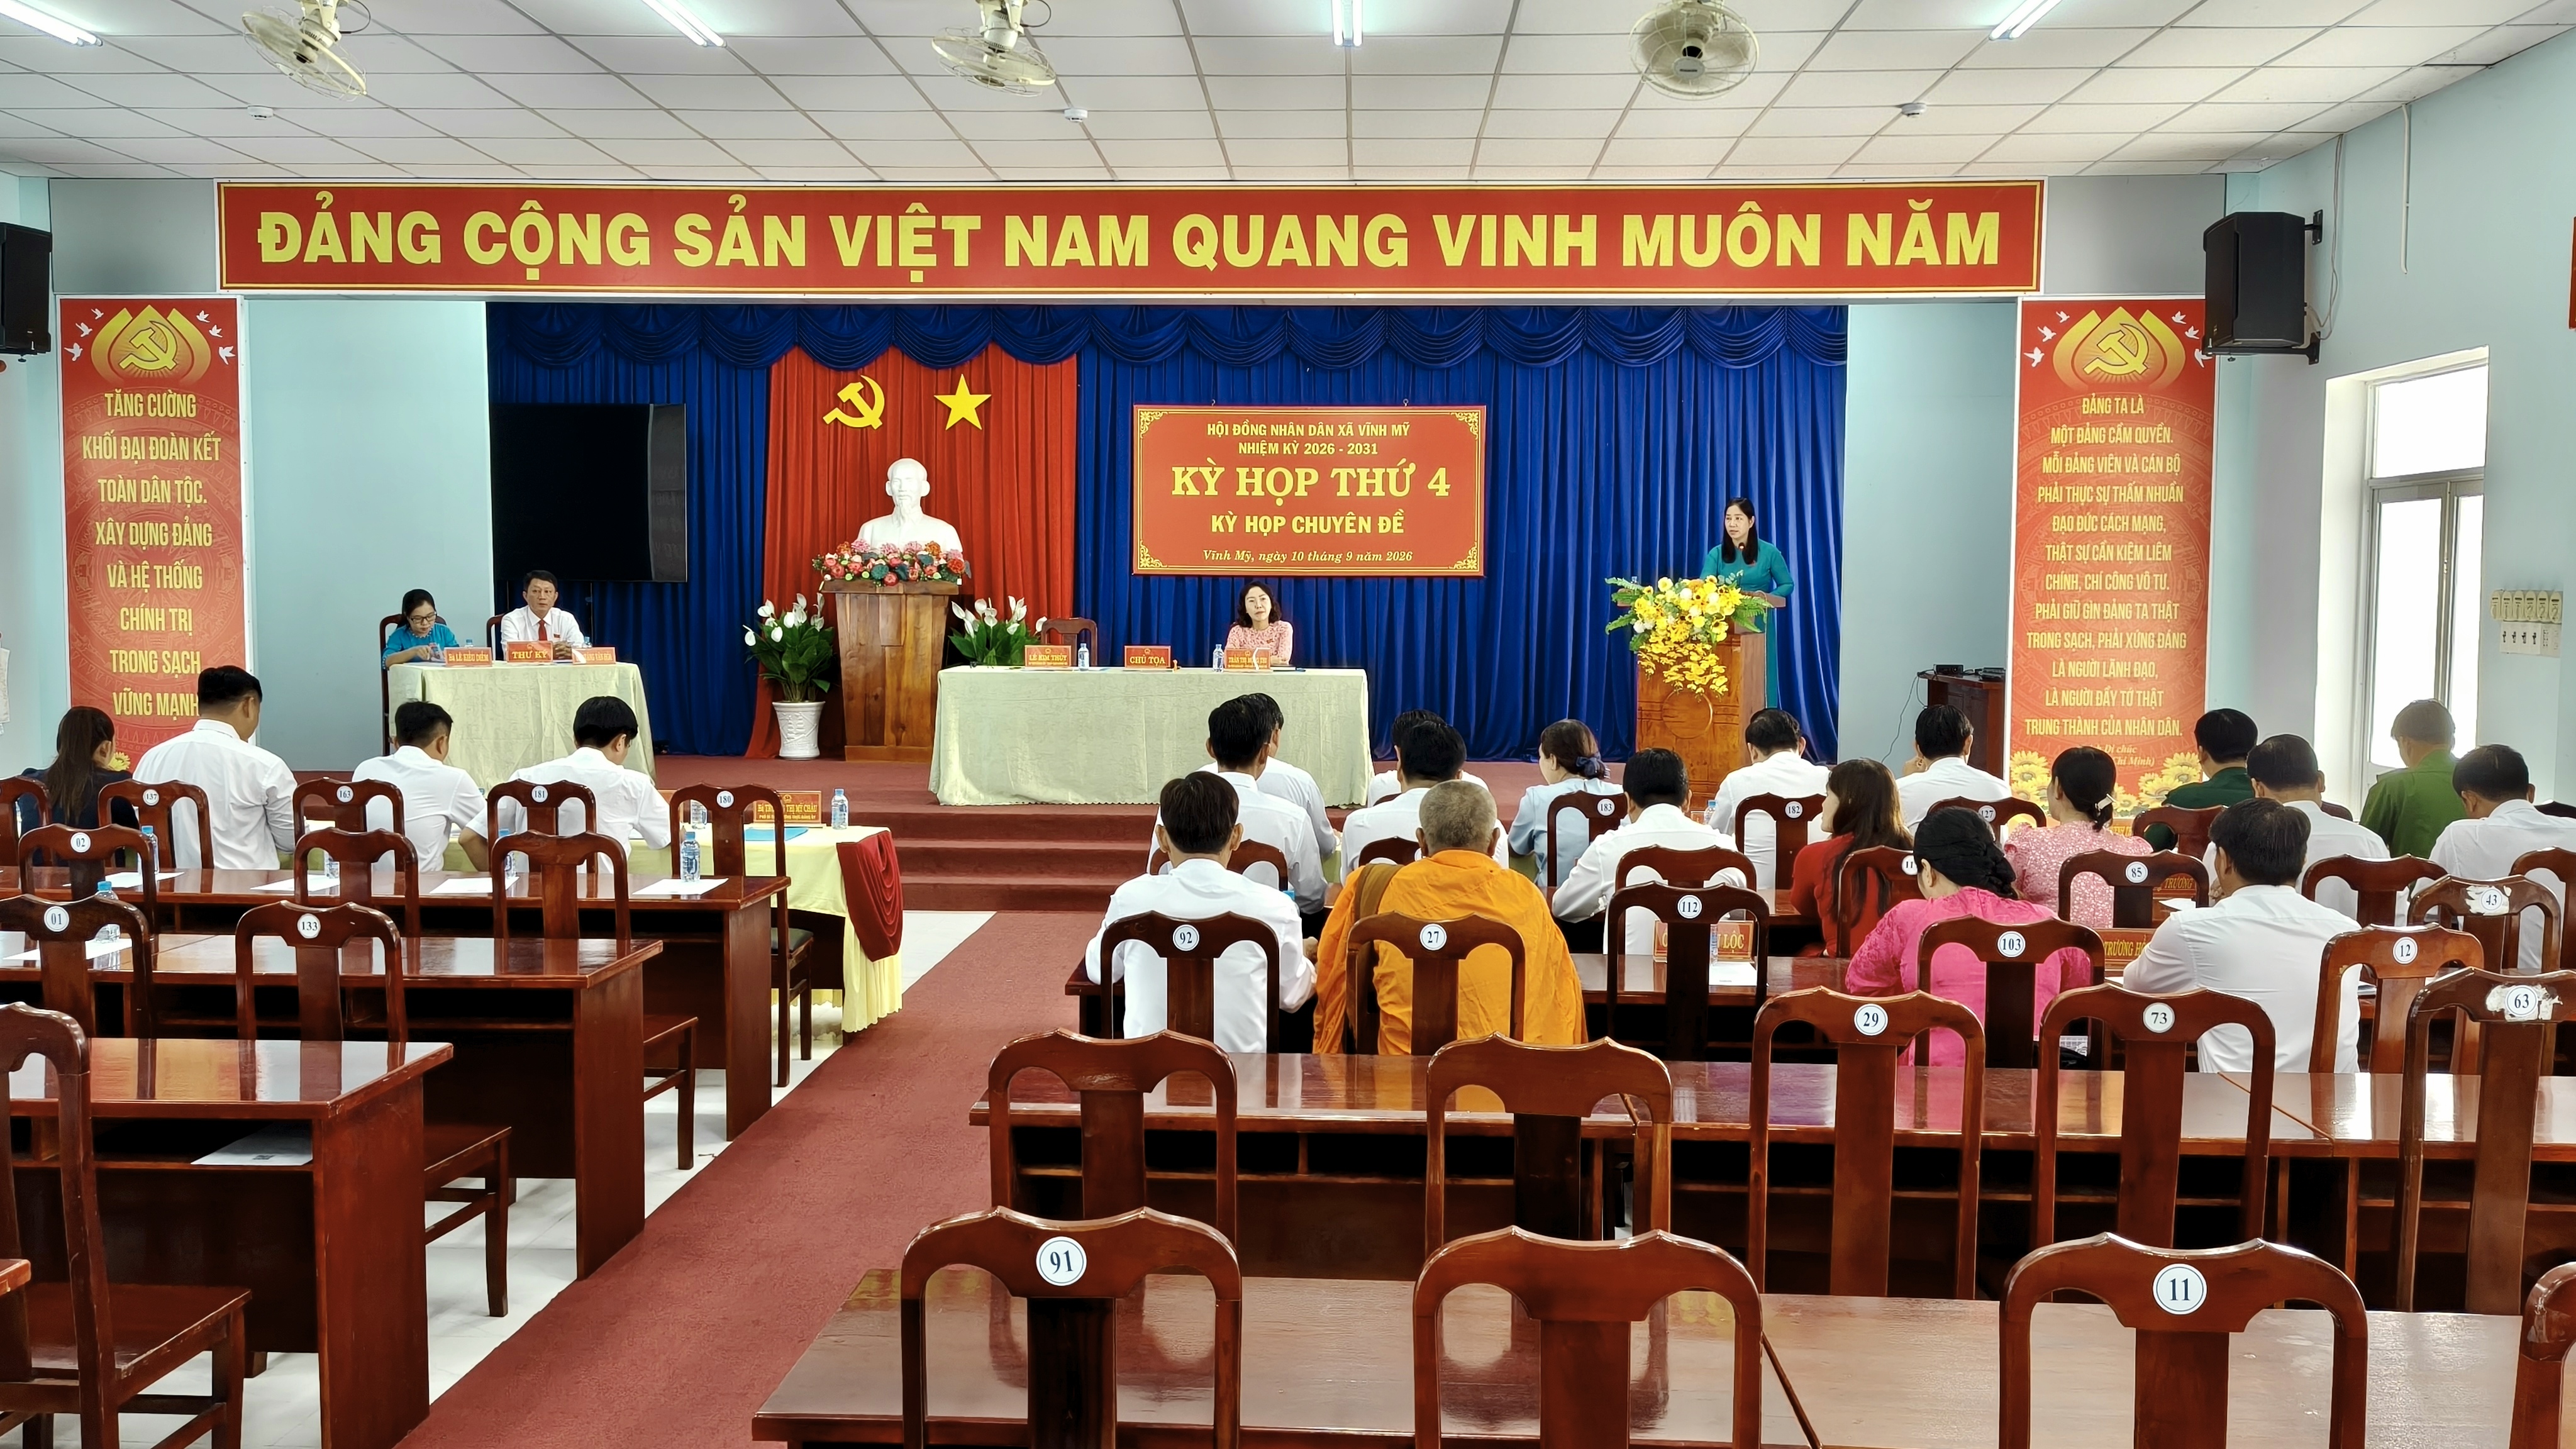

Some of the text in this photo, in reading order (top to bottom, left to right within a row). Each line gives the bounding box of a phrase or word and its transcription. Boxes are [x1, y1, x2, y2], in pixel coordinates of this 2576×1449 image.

[257, 191, 1999, 284] ĐẢNG CỘNG SẢN VIỆT NAM QUANG VINH MUÔN NĂM
[104, 389, 196, 418] TĂNG CƯỜNG
[2082, 392, 2145, 414] ĐẢNG TA LÀ
[1207, 419, 1410, 438] HỘI ĐỒNG NHÂN DÂN XÃ VĨNH MỸ
[2051, 421, 2174, 447] MỘT ĐẢNG CẦM QUYỀN.
[82, 429, 221, 465] KHỐI ĐẠI ĐOÀN KẾT
[1238, 440, 1378, 457] NHIỆM KỲ 2026 2031
[2042, 450, 2180, 476] MỖI ĐẢNG VIÊN VÀ CÁN BỘ
[97, 474, 208, 508] TOÀN DÂN TỘC.
[1172, 457, 1451, 506] KỲ HỌP THỨ 4
[2038, 480, 2184, 506] PHẢI THỰC SỰ THẤM NHUẦN
[95, 515, 213, 550] XÂY DỰNG ĐẢNG
[1211, 508, 1404, 536] KỲ HỌP CHUYÊN ĐỀ
[2051, 512, 2167, 535] ĐẠO ĐỨC CÁCH MẠNG,
[1202, 550, 1413, 564] Vĩnh Mỹ, ngày 10 tháng 9 năm 2026
[2045, 539, 2172, 565] THẬT SỰ CẦN KIỆM LIÊM
[107, 558, 203, 593] VÀ HỆ THỐNG
[2045, 570, 2170, 592] CHÍNH, CHÍ CÔNG VÔ TƯ.
[120, 603, 192, 636] CHÍNH TRỊ
[2035, 597, 2180, 623] PHẢI GIỮ GÌN ĐẢNG TA THẬT
[2026, 627, 2186, 652] TRONG SẠCH, PHẢI XỨNG ĐÁNG
[109, 650, 201, 679] TRONG SẠCH
[511, 649, 548, 659] THƯ KÝ
[1130, 654, 1165, 667] CHỦ TỌA
[2052, 658, 2158, 681] LÀ NGƯỜI LÃNH ĐẠO,
[114, 689, 200, 721] VỮNG MẠNH
[2045, 687, 2059, 706] LÀ
[2061, 687, 2094, 706] NGƯỜI
[2119, 687, 2135, 707] TỚ
[2135, 687, 2164, 710] THẬT
[2024, 714, 2182, 736] TRUNG THÀNH CỦA NHÂN DÂN.
[2116, 744, 2138, 753] chúc
[2129, 756, 2155, 767] Minh)
[340, 790, 351, 799] 163
[535, 790, 545, 799] 181
[719, 795, 731, 804] 180
[1601, 803, 1613, 812] 183
[1788, 806, 1801, 814] 182
[76, 838, 86, 848] 02
[2131, 867, 2143, 878] 85
[1682, 901, 1697, 913] 112
[2485, 894, 2497, 906] 43
[51, 913, 62, 925] 01
[302, 921, 318, 931] 133
[1180, 931, 1192, 944] 92
[1427, 931, 1440, 943] 27
[1723, 930, 1745, 953] LỘC
[2002, 938, 2021, 951] 103
[2401, 944, 2411, 957] 12
[2514, 994, 2529, 1009] 63
[1863, 1012, 1879, 1027] 29
[2151, 1012, 2167, 1024] 73
[1050, 1250, 1073, 1274] 91
[2170, 1278, 2190, 1301] 11
